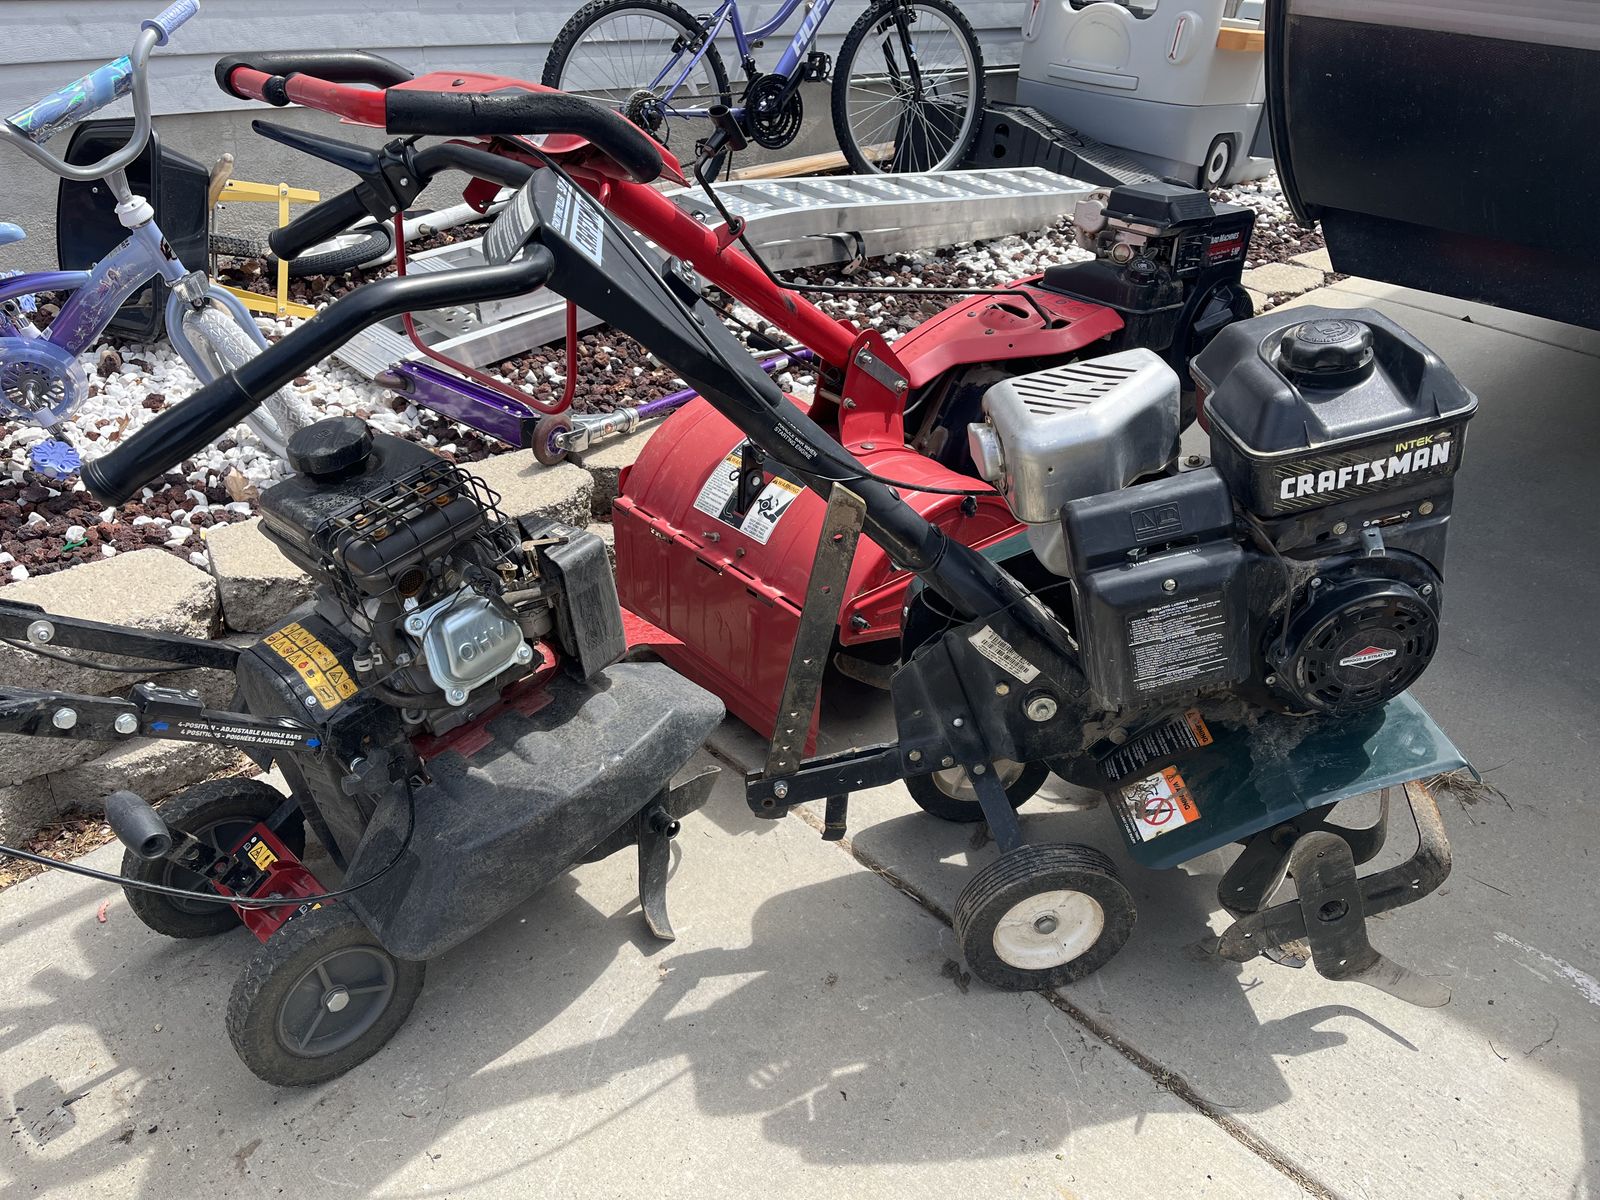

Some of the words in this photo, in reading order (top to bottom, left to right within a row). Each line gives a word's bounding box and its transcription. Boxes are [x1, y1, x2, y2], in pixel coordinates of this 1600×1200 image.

[791, 0, 834, 57] HUF
[576, 199, 598, 256] CRAFTSMA
[774, 426, 796, 446] STARTING
[795, 444, 812, 460] ENGINE
[1396, 434, 1434, 454] INTEK
[1280, 441, 1450, 500] CRAFTSMAN
[458, 621, 508, 662] OHV
[1368, 652, 1394, 660] STRATTON
[220, 726, 260, 736] ADJUSTABLE
[261, 730, 284, 738] HANDLE
[285, 732, 302, 740] BARS
[226, 733, 256, 742] POIGNÉES
[256, 736, 295, 746] AJUSTABLES
[1173, 781, 1190, 810] WANING
